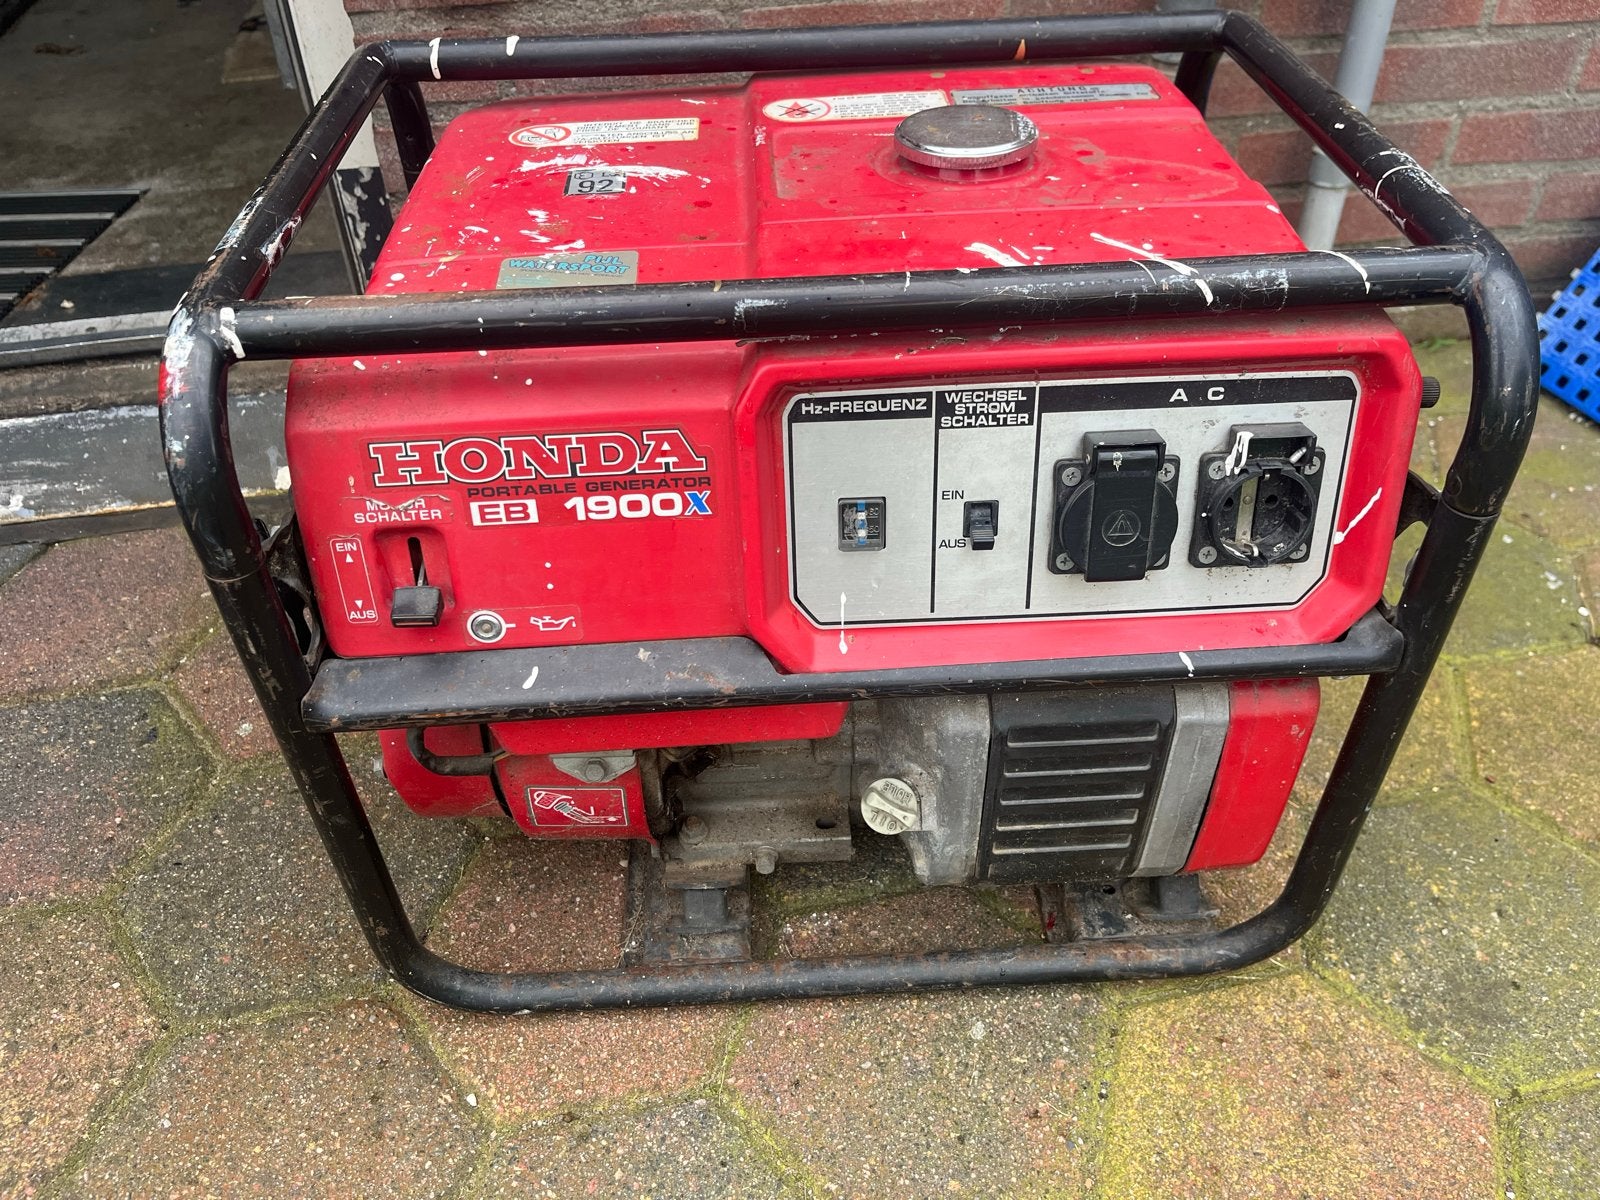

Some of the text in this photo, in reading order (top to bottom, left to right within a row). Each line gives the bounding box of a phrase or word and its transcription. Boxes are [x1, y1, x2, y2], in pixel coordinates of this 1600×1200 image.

[1017, 86, 1087, 94] ACHTUNG
[577, 180, 613, 192] 92
[584, 254, 623, 265] PIJL
[945, 389, 1027, 404] WECHSEL
[1169, 386, 1225, 402] A C
[801, 398, 927, 415] Hz-FREQUENZ
[954, 402, 1016, 415] STROM
[940, 413, 1030, 428] SCHALTER
[368, 428, 709, 488] HONDA
[467, 477, 712, 498] PORTABLE GENERATOR
[942, 490, 965, 500] EIN
[475, 490, 713, 524] EB 1900X
[354, 509, 442, 524] SCHALTER
[335, 542, 358, 552] EIN
[939, 538, 967, 549] AUS
[349, 610, 376, 619] AUS
[871, 810, 896, 831] OIL
